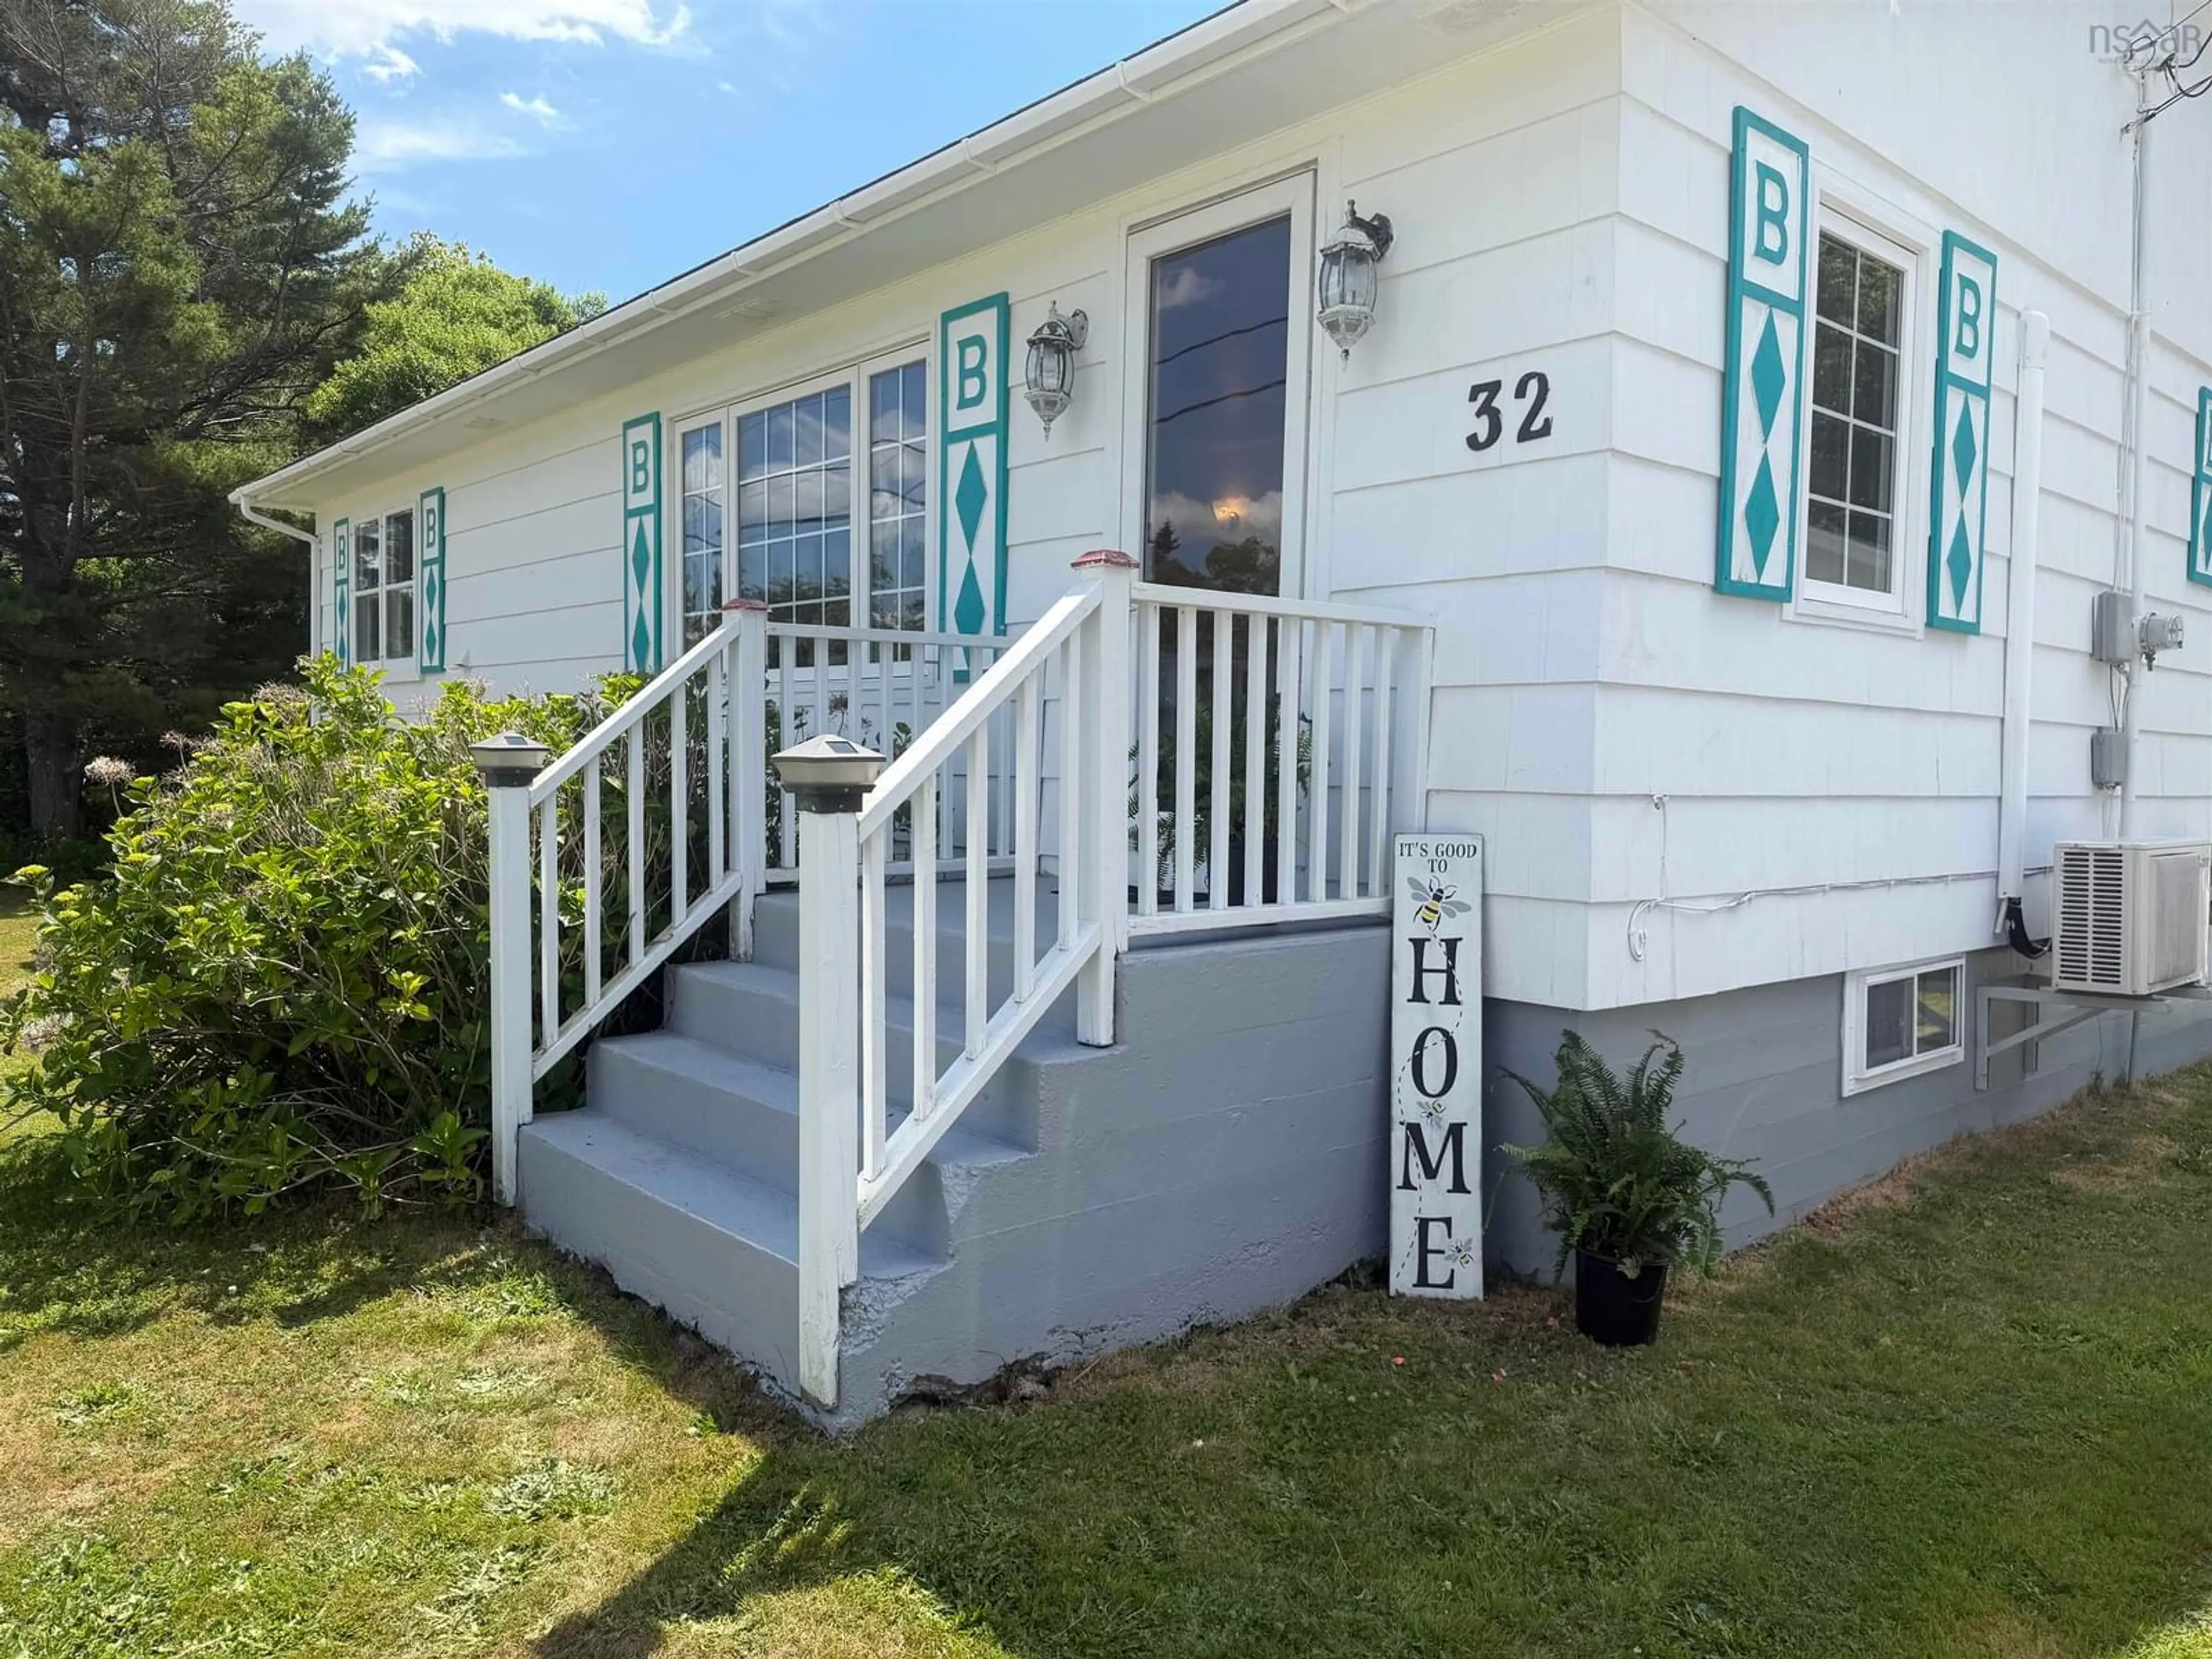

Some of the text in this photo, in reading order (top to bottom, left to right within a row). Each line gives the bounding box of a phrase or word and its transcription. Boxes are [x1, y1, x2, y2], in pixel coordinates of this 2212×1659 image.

[1755, 160, 1789, 266] B
[1955, 273, 1982, 359] B
[956, 334, 987, 410] B
[1465, 372, 1553, 451] 32
[631, 440, 649, 494] B
[339, 535, 346, 570] B
[426, 507, 435, 548] B
[1399, 842, 1478, 858] IT'S GOOD
[1427, 858, 1448, 873] TO
[1396, 937, 1472, 1289] HOME
